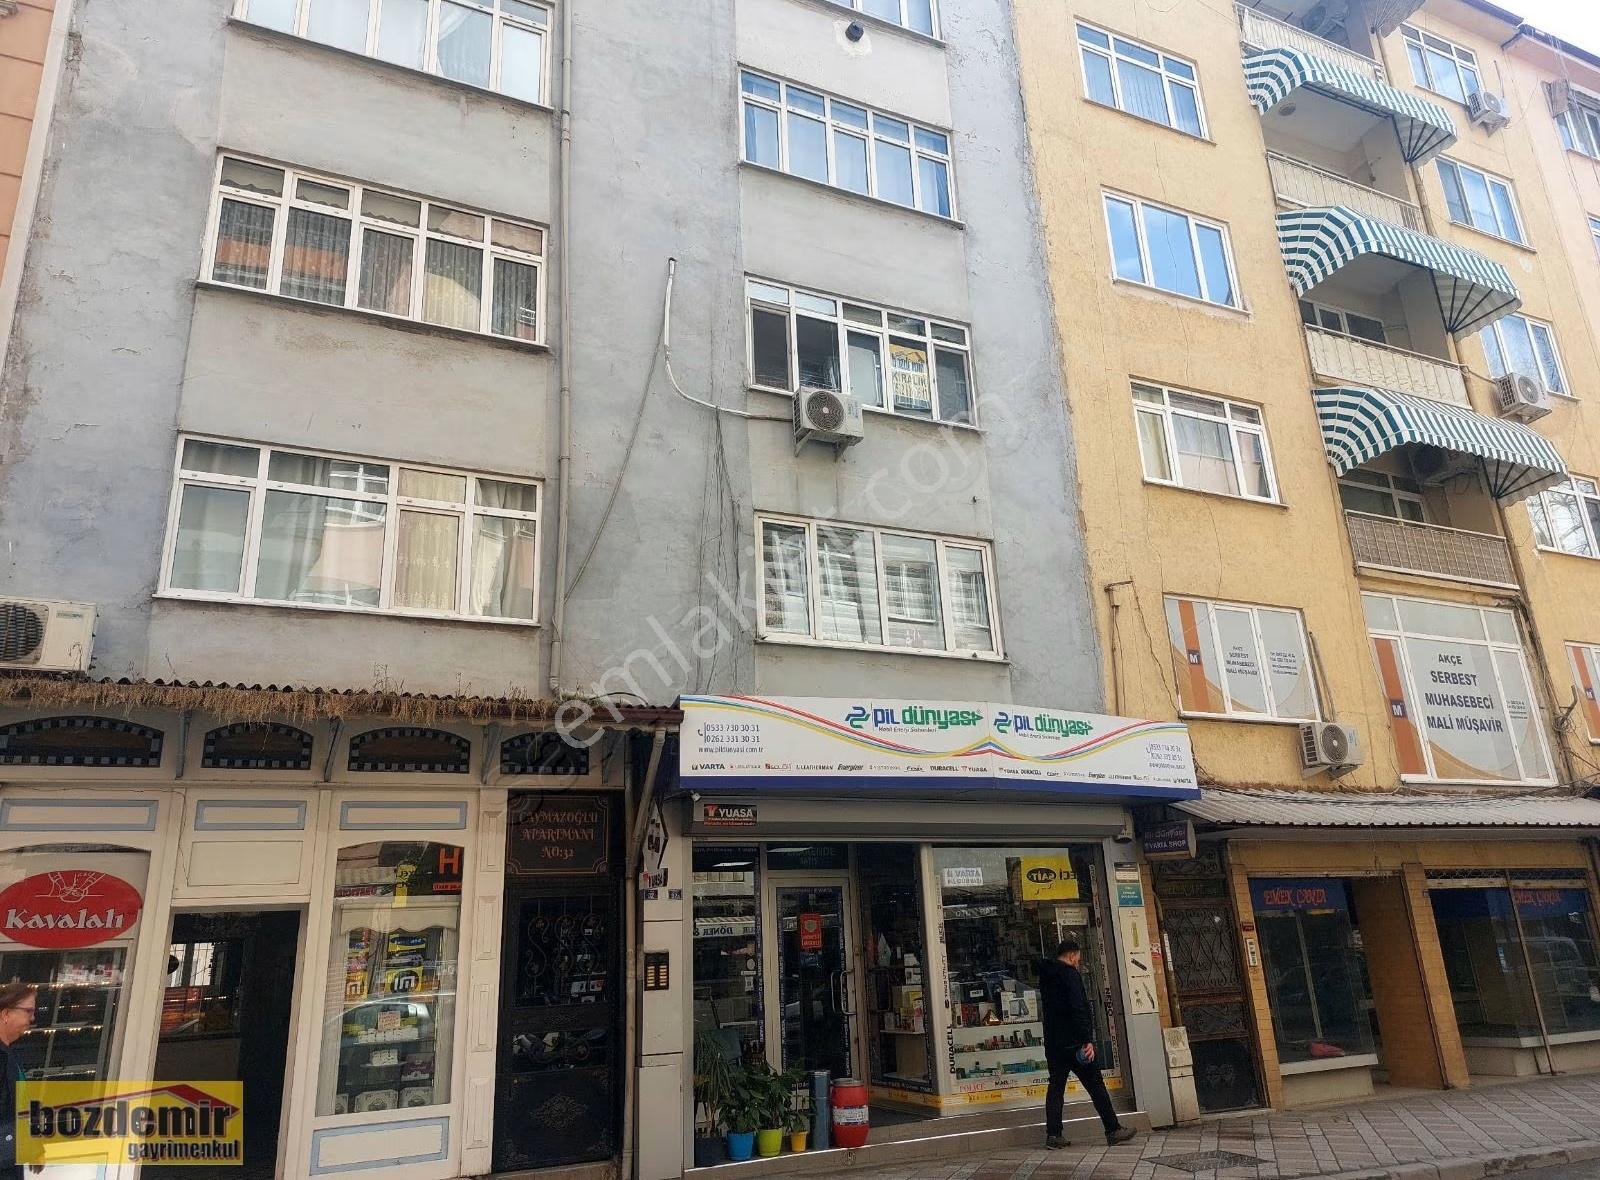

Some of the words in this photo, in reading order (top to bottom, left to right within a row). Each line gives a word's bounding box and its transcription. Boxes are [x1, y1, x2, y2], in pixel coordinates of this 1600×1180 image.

[1438, 653, 1463, 667] AKÇE
[1430, 670, 1477, 687] SERBEST
[1425, 692, 1494, 710] MUHASEBECİ
[706, 723, 724, 732] 0533
[740, 723, 750, 732] 30
[1426, 713, 1454, 730] MALİ
[1456, 715, 1504, 734] MÜŞAVİR
[706, 735, 724, 743] 0262
[726, 735, 739, 743] 331
[741, 735, 750, 743] 30
[752, 735, 760, 743] 31
[718, 808, 754, 818] YUASA
[5, 907, 124, 929] Kavalalı
[946, 1025, 956, 1074] DURACELL
